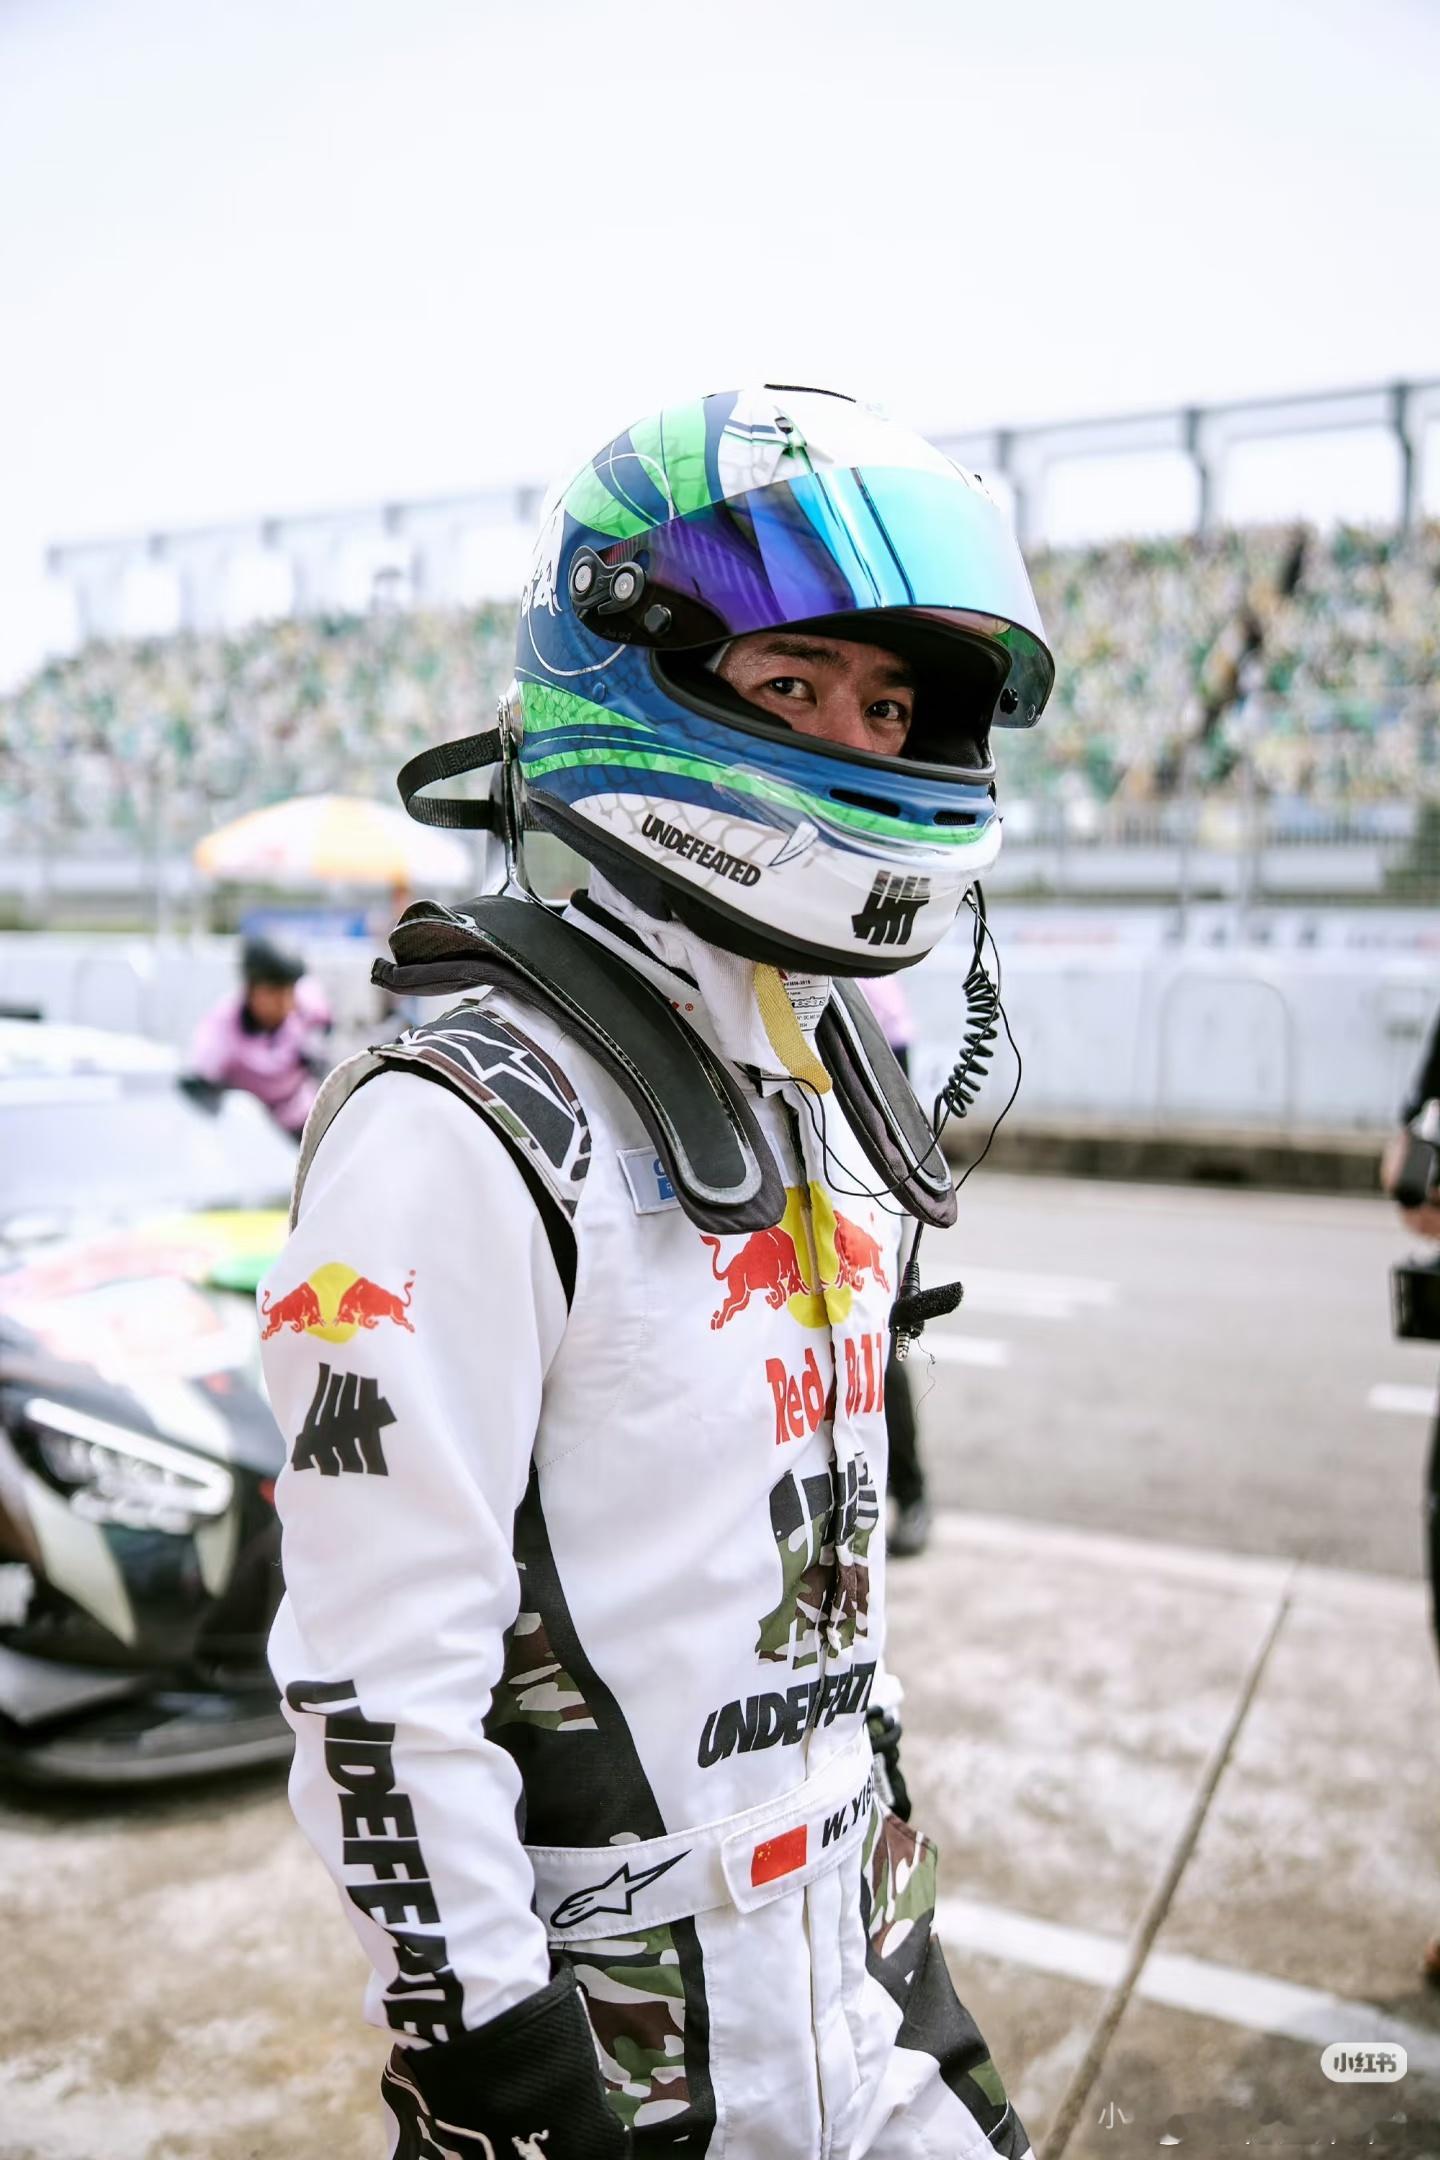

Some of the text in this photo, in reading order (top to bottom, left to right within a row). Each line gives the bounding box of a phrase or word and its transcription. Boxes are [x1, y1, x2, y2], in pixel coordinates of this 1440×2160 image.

[641, 813, 761, 887] UNDEFEATED
[765, 1347, 825, 1445] Red
[697, 1661, 877, 1769] UNDEFEAT
[851, 1765, 875, 1827] YIB
